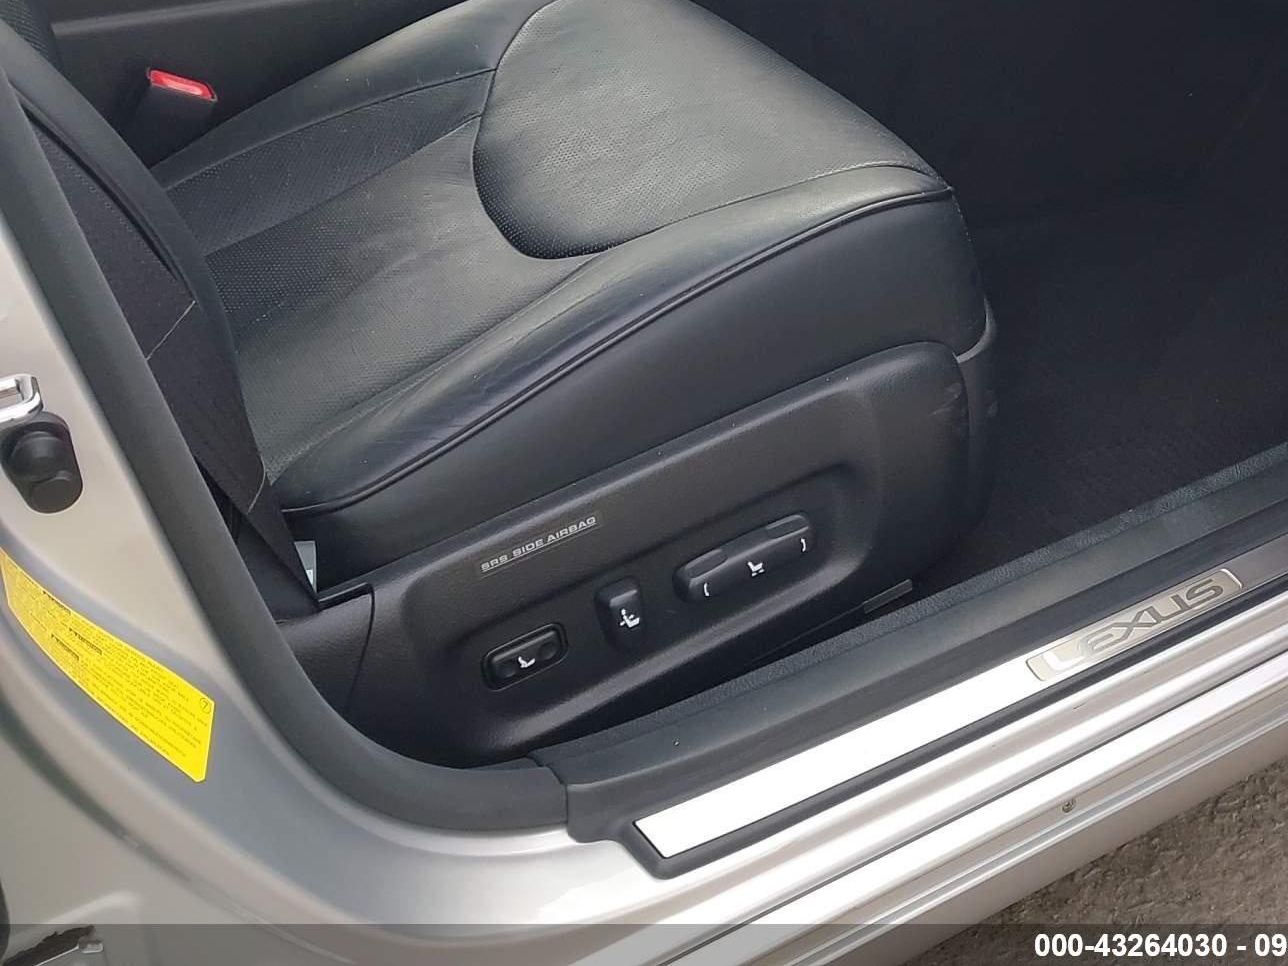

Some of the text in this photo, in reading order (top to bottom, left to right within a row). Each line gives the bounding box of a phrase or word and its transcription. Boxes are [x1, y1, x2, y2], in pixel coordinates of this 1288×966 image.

[481, 516, 597, 572] SRS SIDE AIRBAG
[1041, 578, 1224, 673] LEXUS
